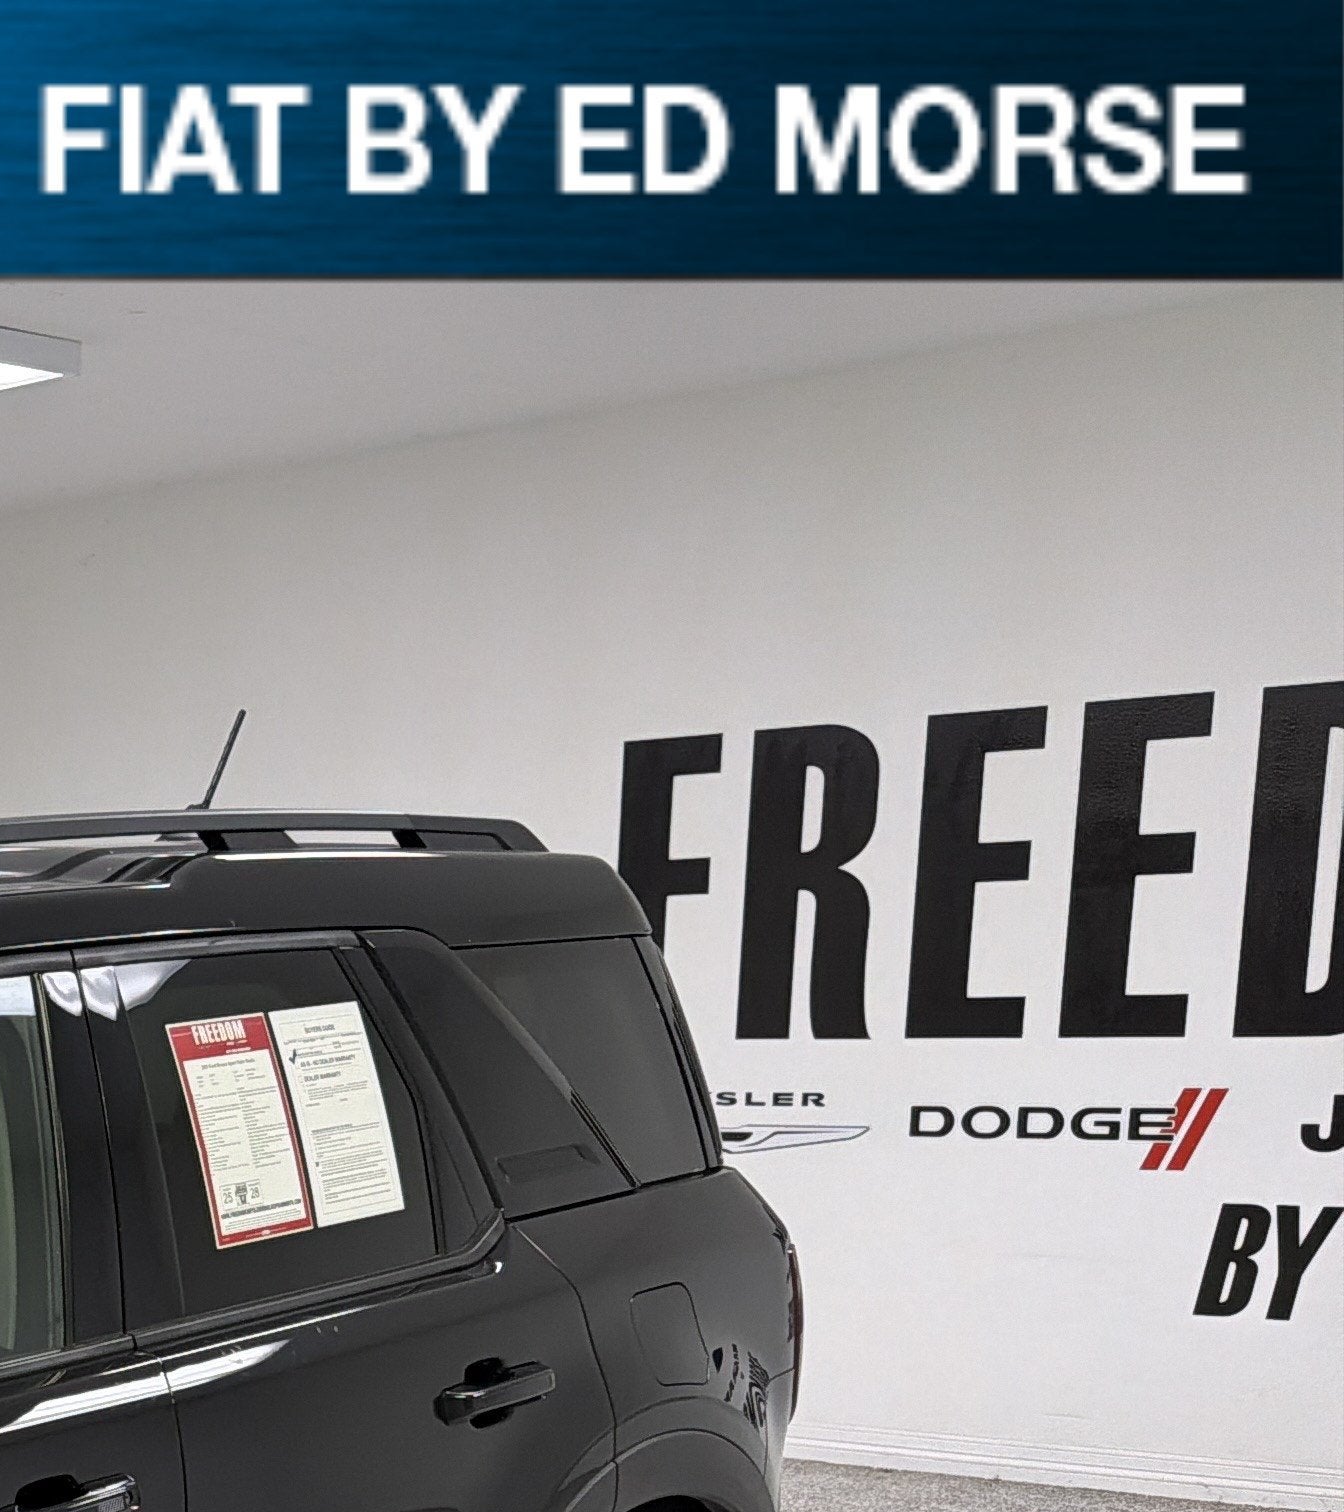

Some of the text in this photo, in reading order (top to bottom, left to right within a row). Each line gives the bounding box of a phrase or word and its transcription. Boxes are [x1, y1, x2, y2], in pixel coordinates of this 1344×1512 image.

[190, 1019, 247, 1046] FREEDOM
[714, 1091, 825, 1108] SLER
[909, 1106, 1176, 1142] DODGE
[1192, 1202, 1344, 1321] BY
